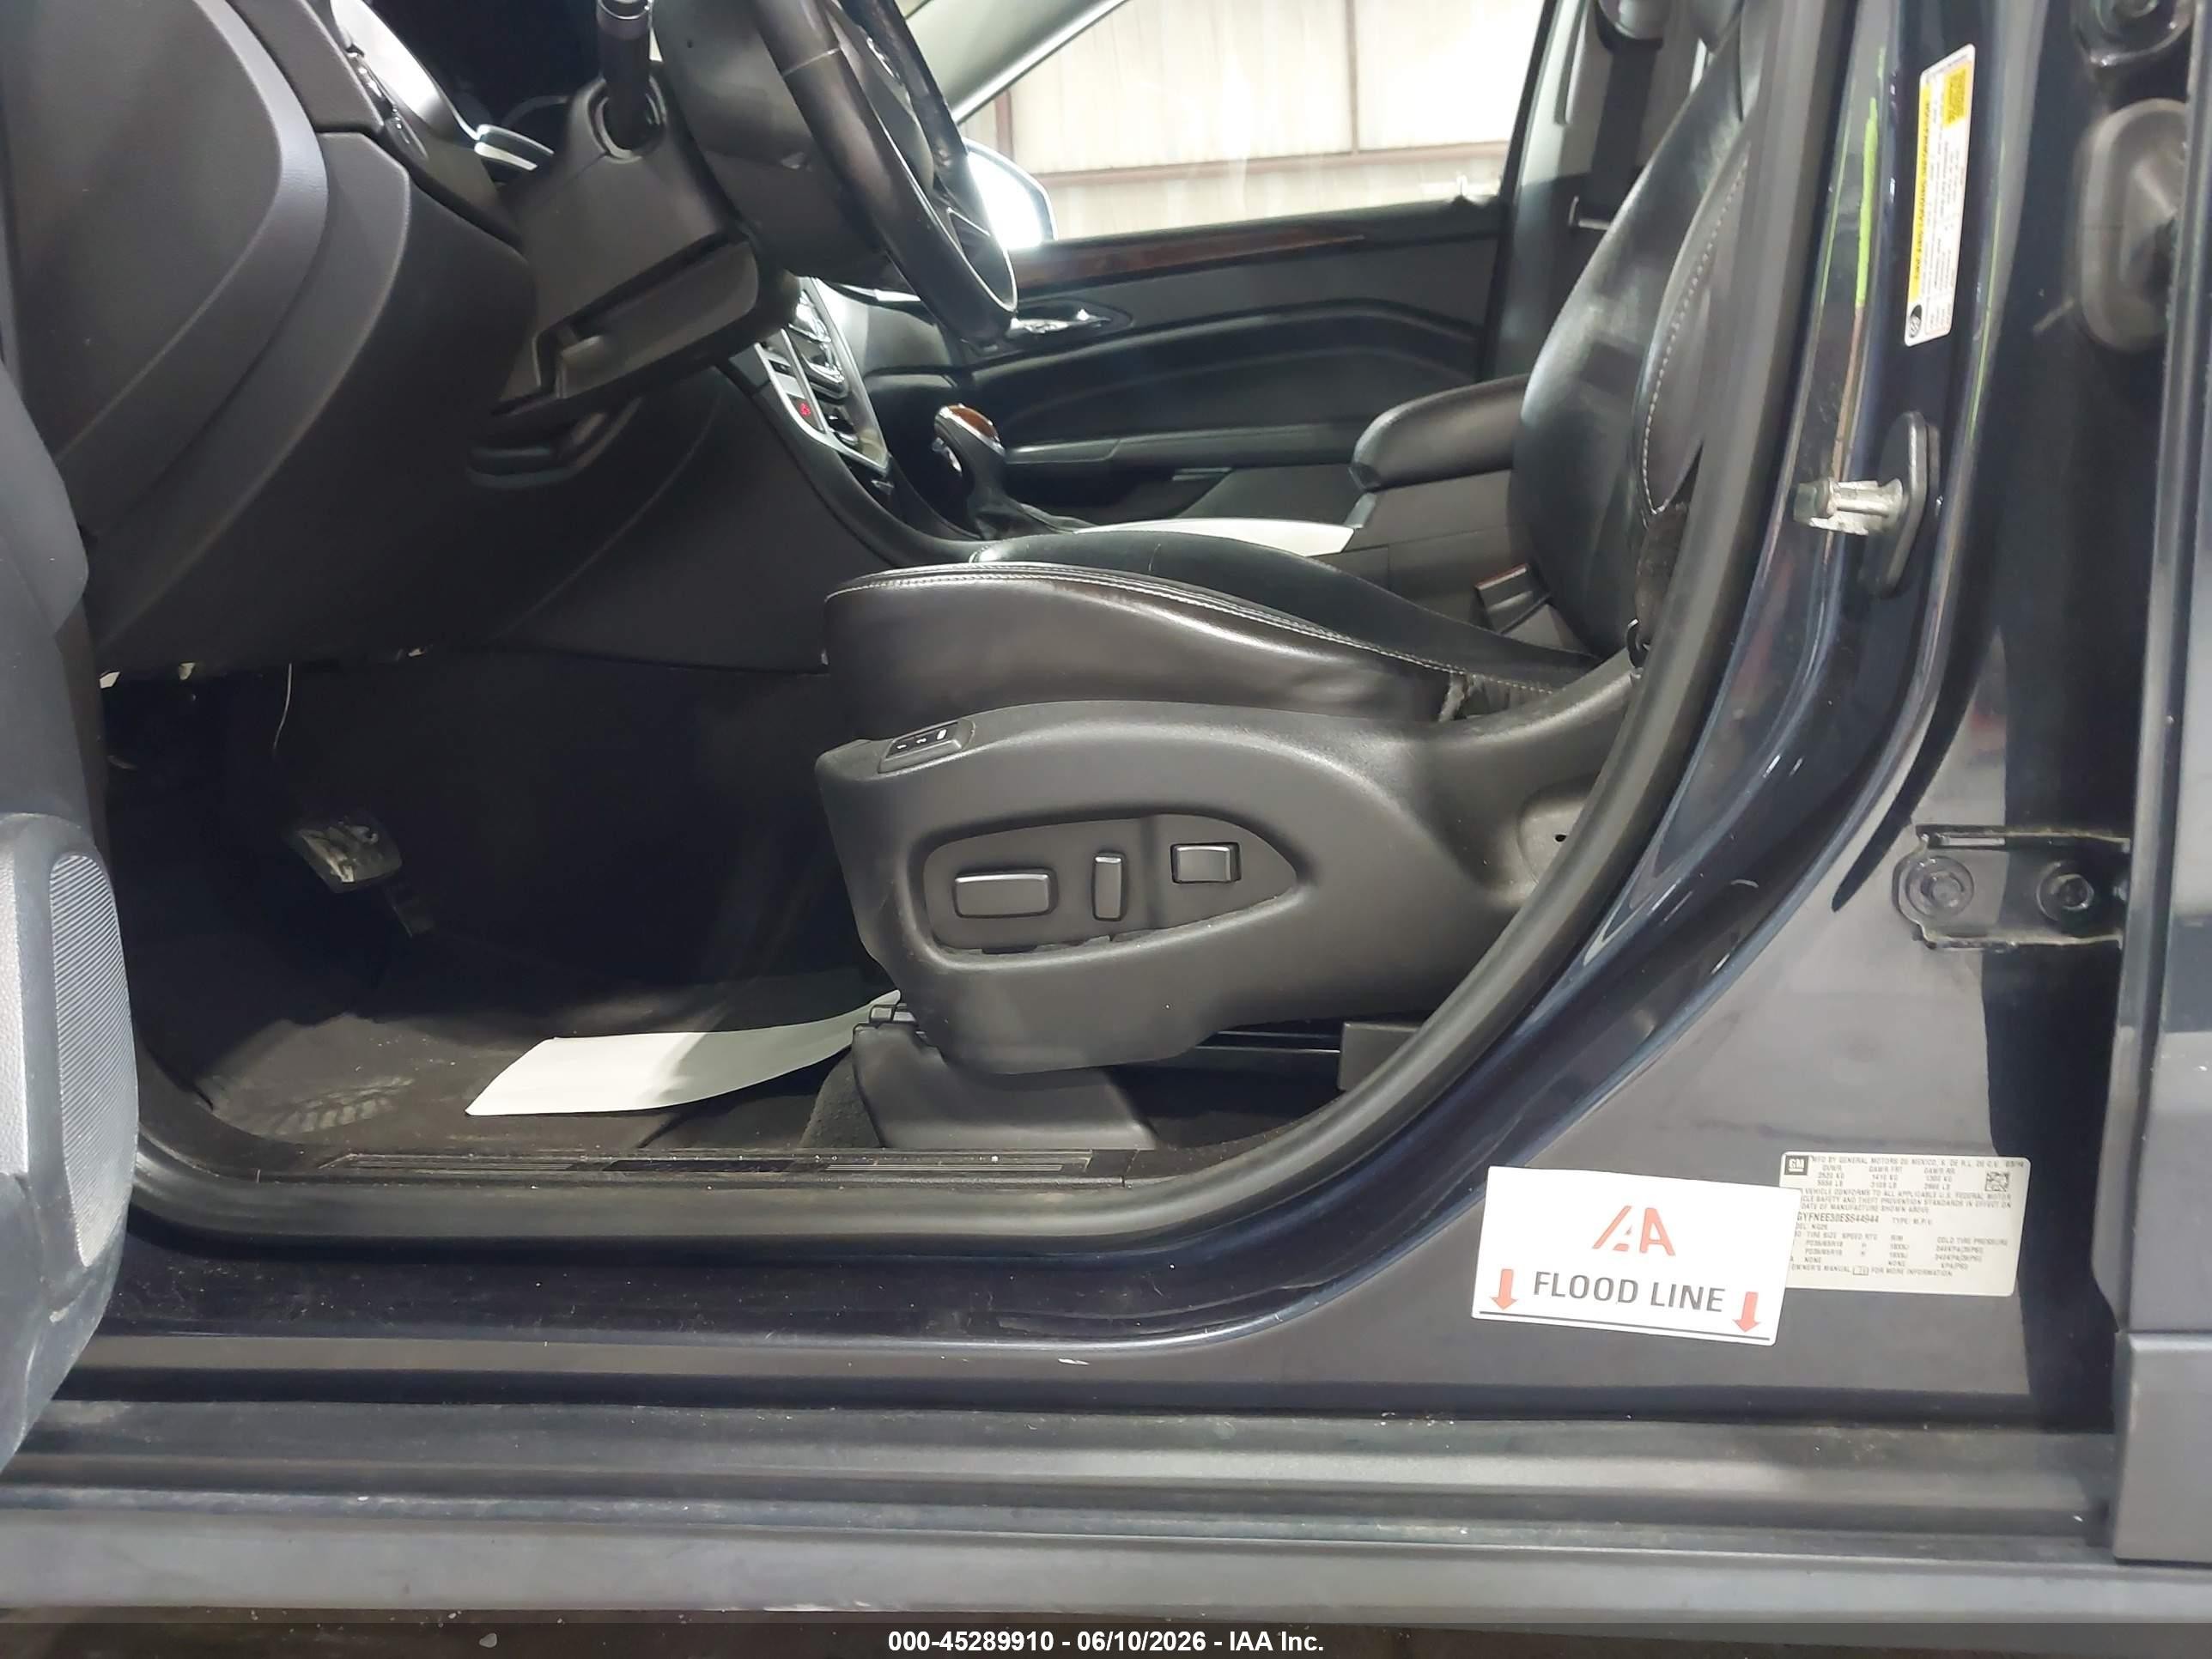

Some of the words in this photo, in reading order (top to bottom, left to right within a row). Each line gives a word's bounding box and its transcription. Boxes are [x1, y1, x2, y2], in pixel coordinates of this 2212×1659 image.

[1789, 1158, 1805, 1169] GM
[1830, 1203, 1879, 1212] MANUFACTURE
[1534, 1271, 1638, 1304] FLOOD
[1650, 1281, 1726, 1312] LINE
